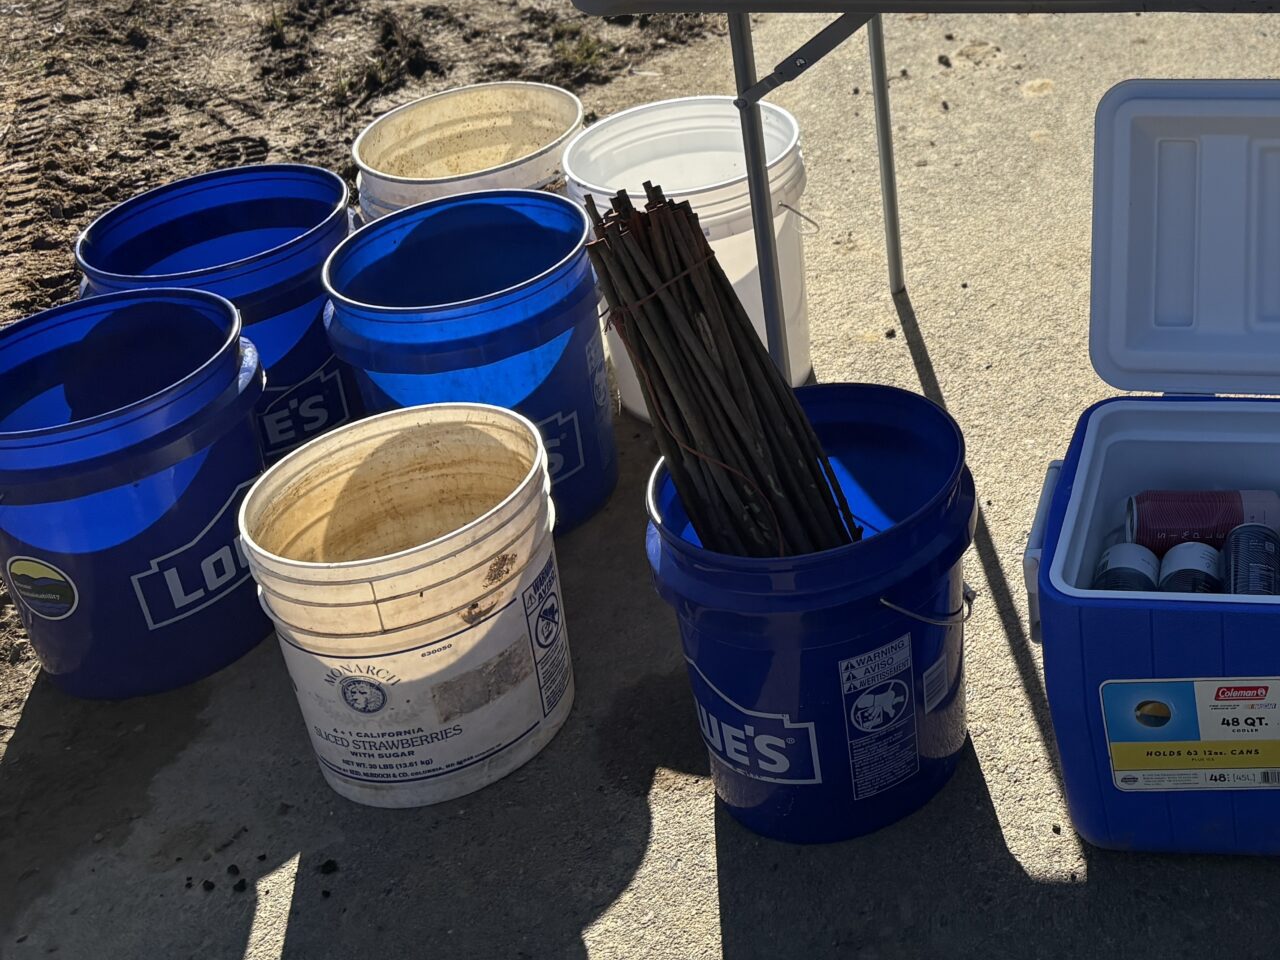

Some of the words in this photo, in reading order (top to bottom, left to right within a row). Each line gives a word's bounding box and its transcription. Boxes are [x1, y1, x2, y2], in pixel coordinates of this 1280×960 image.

[855, 639, 905, 666] WARNING
[863, 656, 894, 676] AVISO
[324, 662, 402, 687] MONARCH
[858, 659, 910, 688] AVERTISSEMENT
[1218, 687, 1257, 698] Coleman
[1221, 717, 1240, 727] 48
[1244, 716, 1269, 728] QT.
[313, 726, 350, 748] SLICED
[351, 724, 463, 751] STRAWBERRIES
[356, 727, 424, 738] CALIFORNIA
[350, 751, 375, 759] WITH
[378, 750, 415, 759] SUGAR
[1230, 748, 1260, 756] CANS
[379, 762, 394, 770] LBS
[1210, 773, 1227, 782] 48
